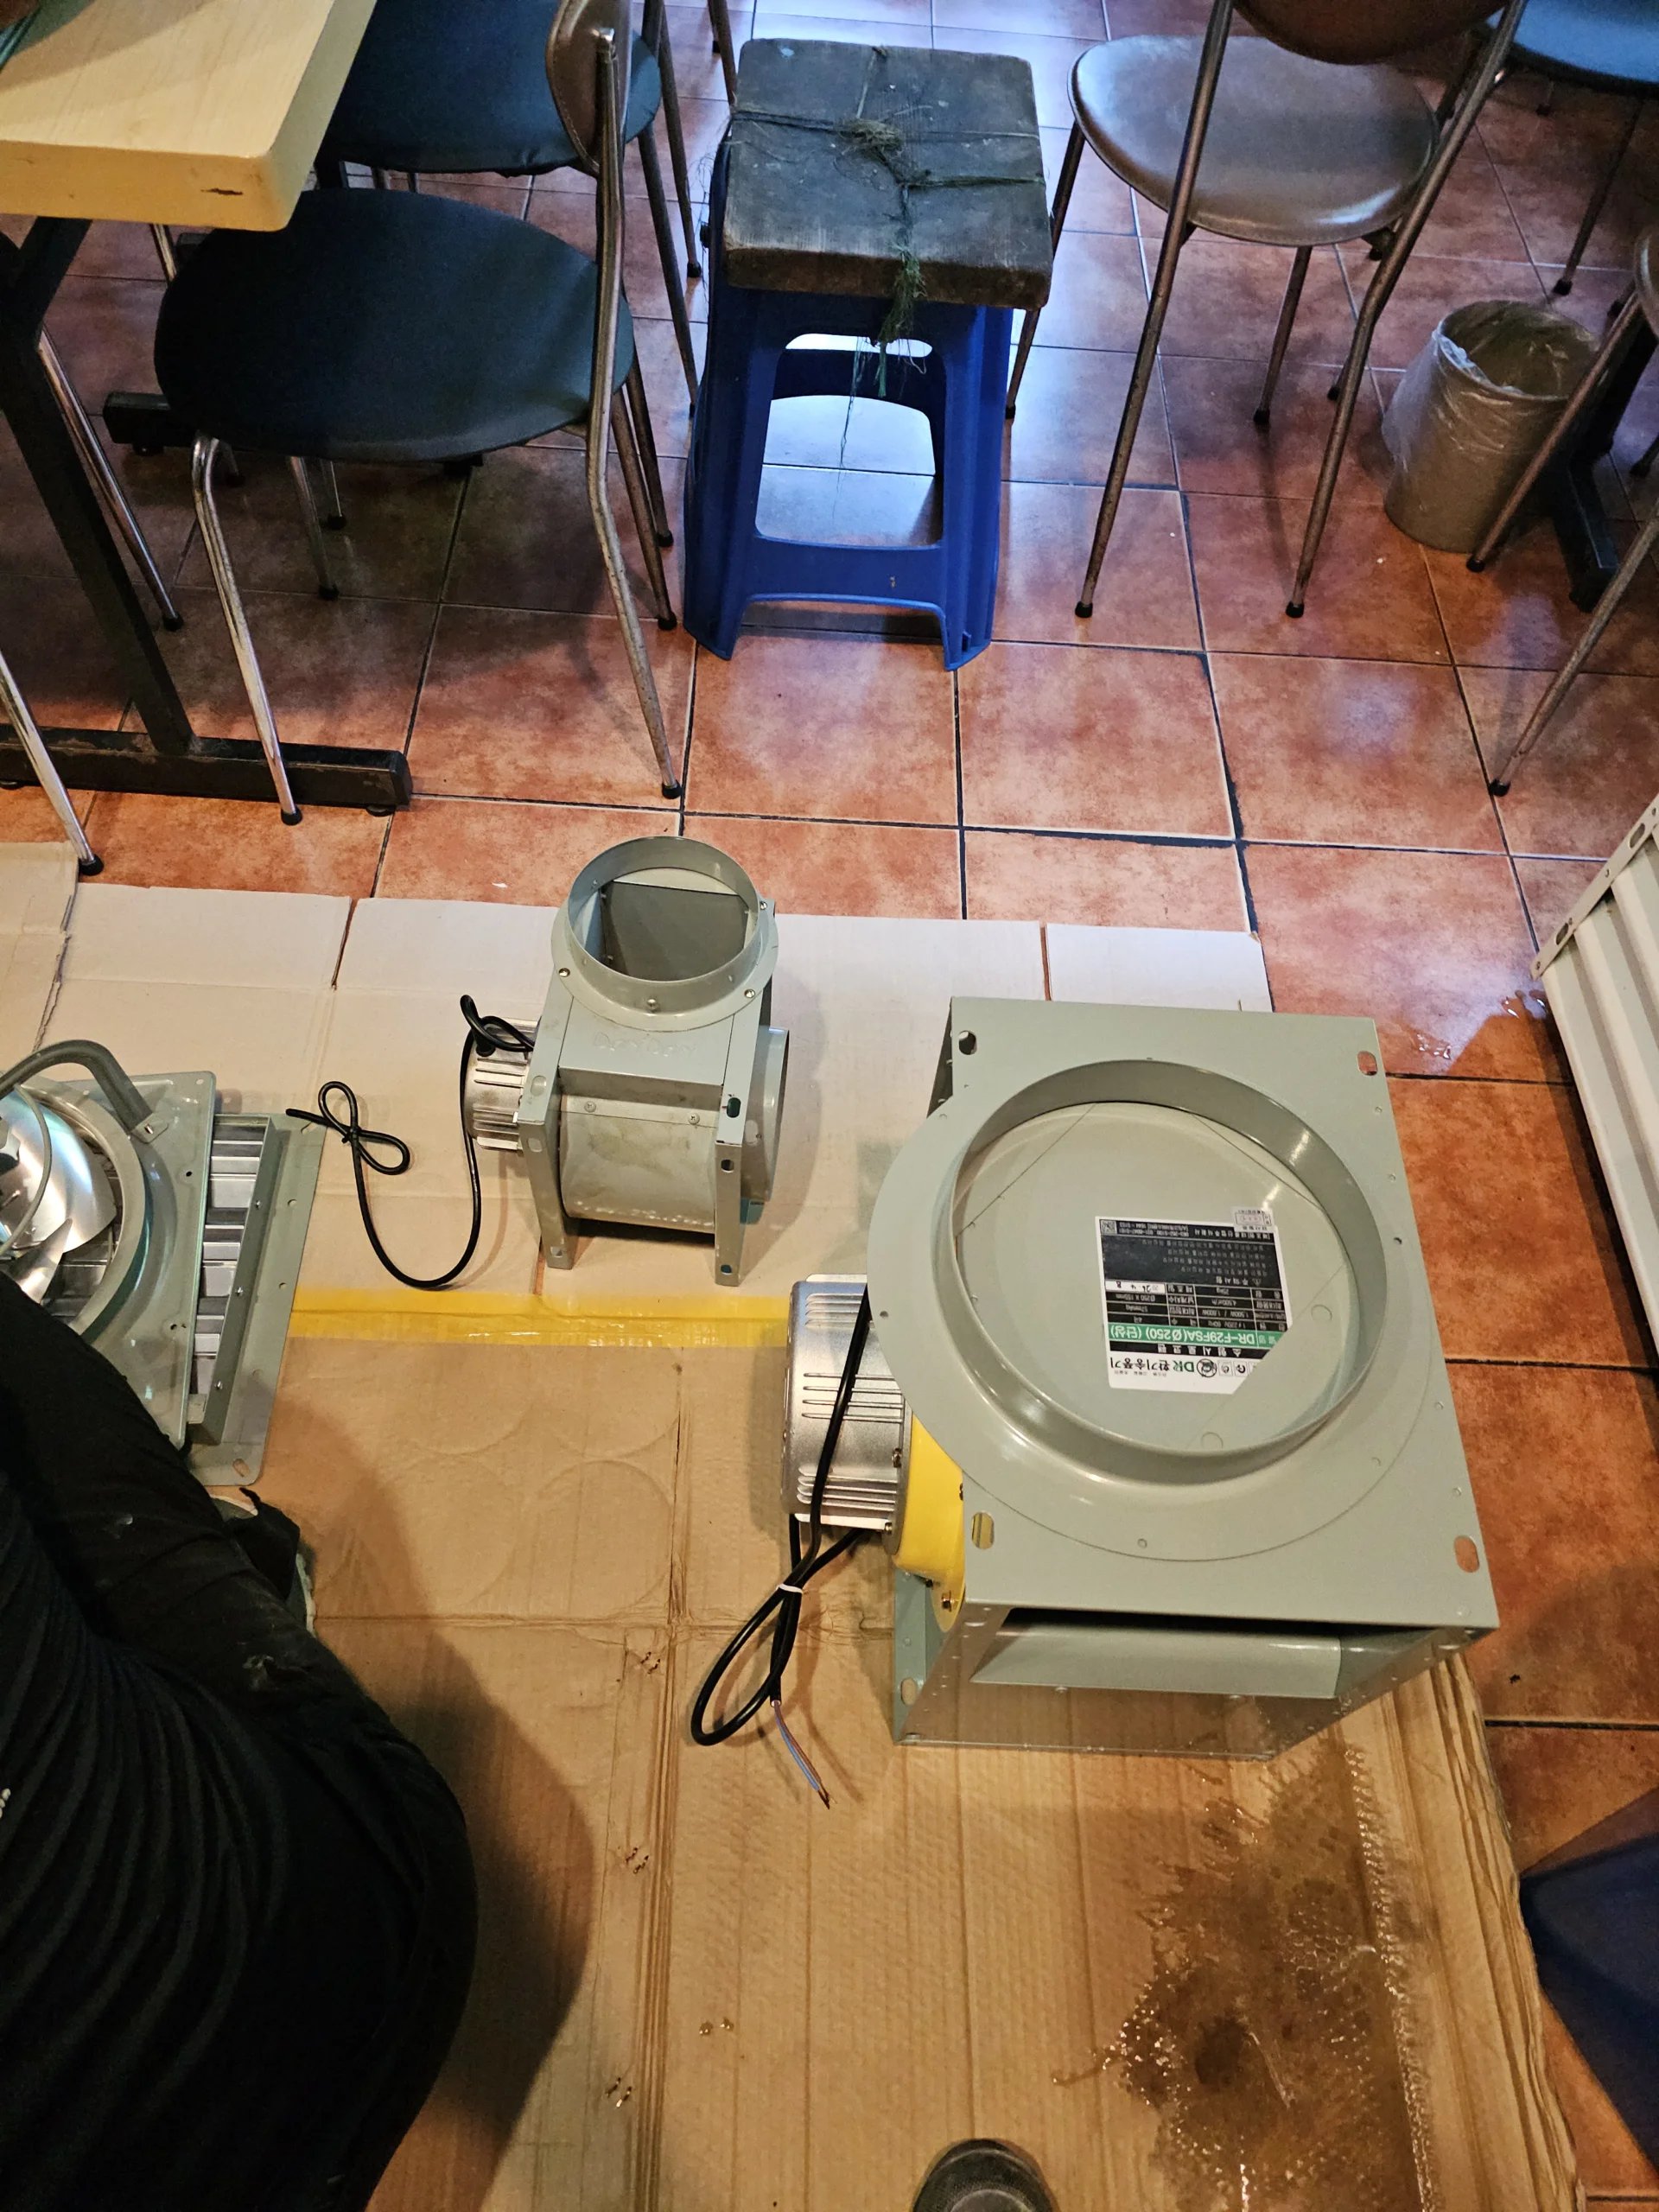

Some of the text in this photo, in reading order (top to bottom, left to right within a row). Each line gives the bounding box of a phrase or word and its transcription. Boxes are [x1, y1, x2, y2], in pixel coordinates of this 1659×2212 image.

[1110, 1325, 1142, 1339] (단상)
[1110, 1357, 1194, 1372] DR 환기송풍기
